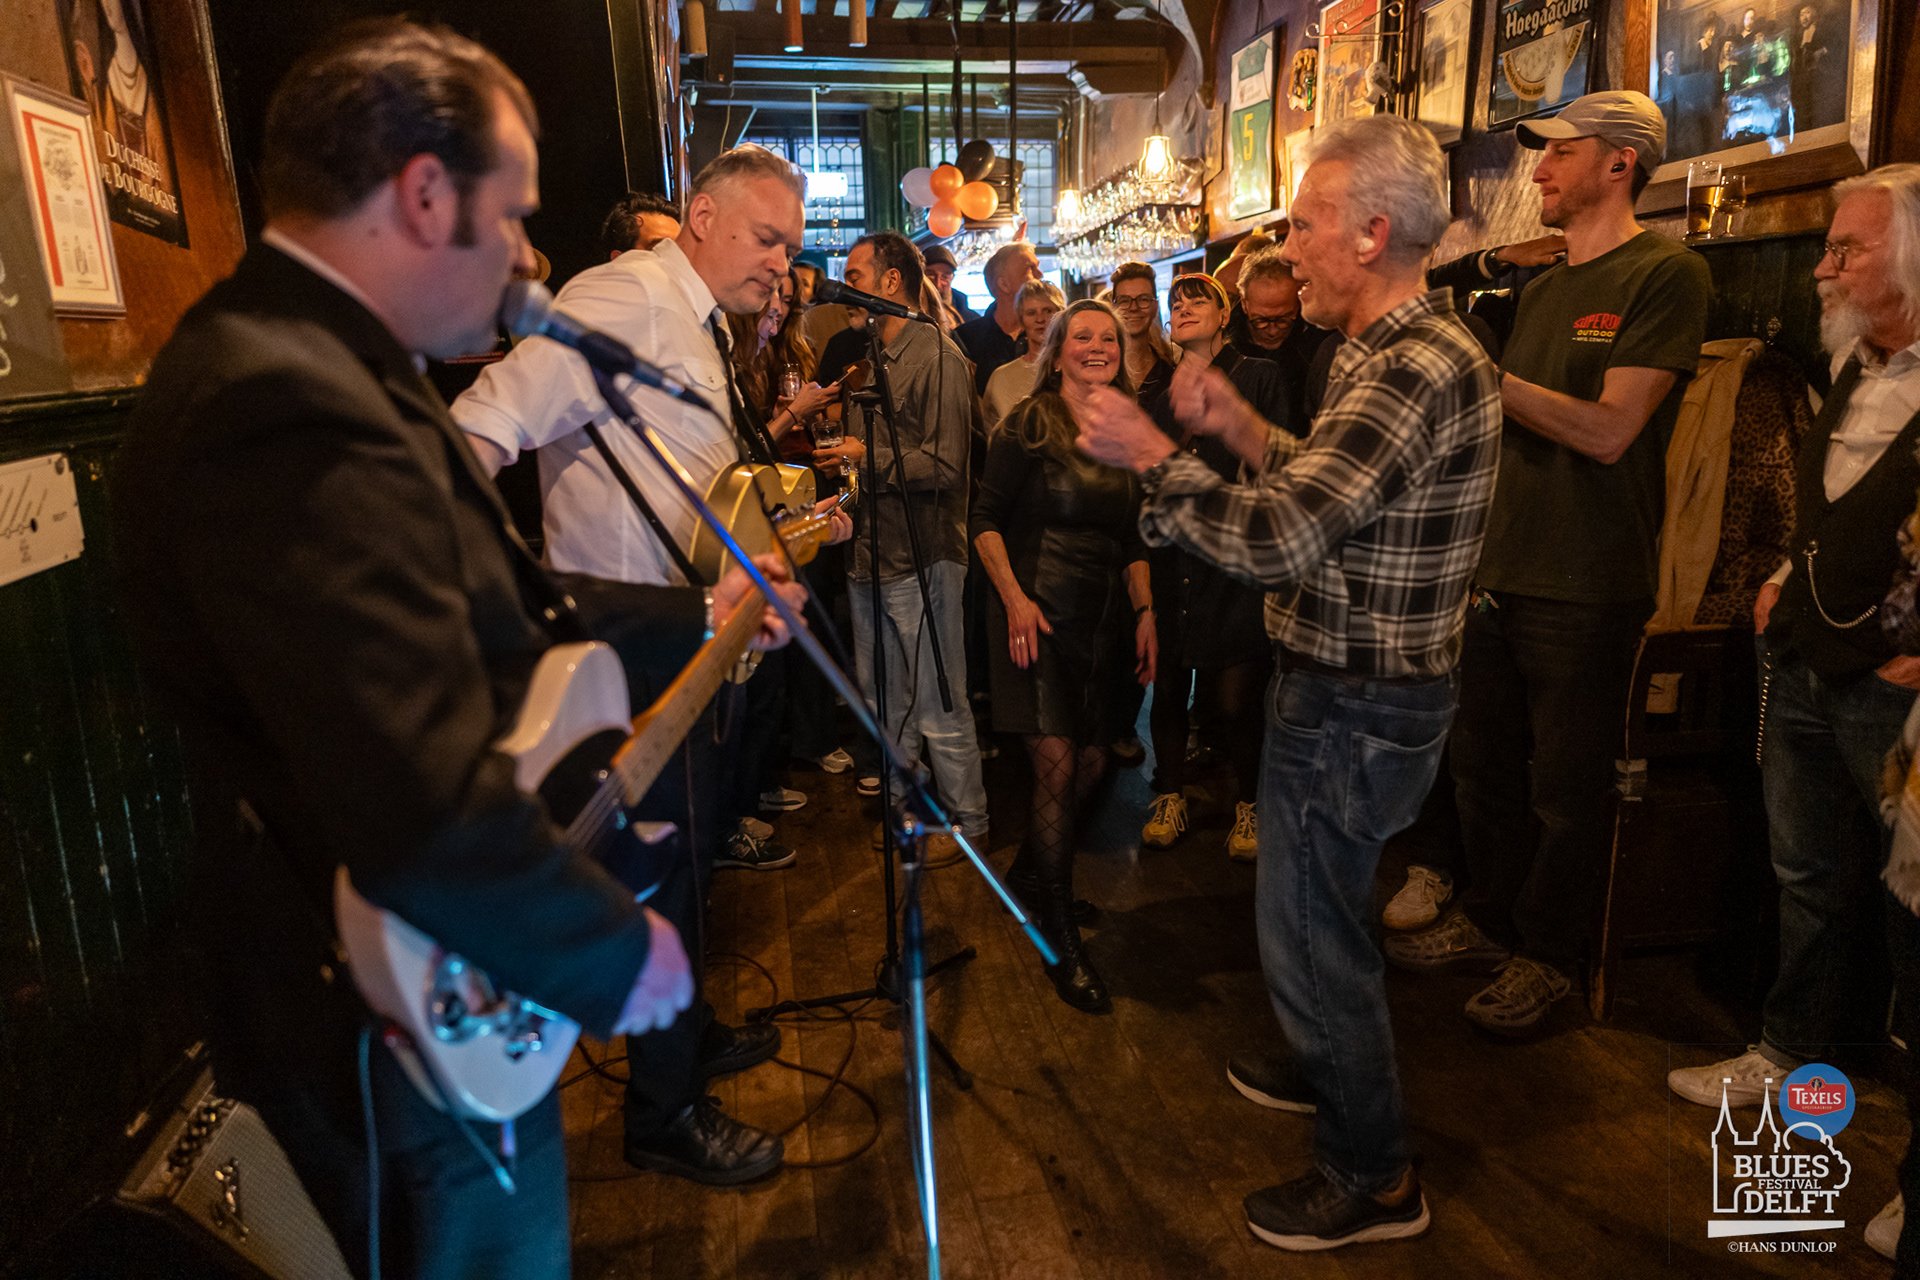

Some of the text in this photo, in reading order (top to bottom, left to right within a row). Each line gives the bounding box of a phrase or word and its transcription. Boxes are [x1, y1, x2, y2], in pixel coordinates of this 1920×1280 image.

[1506, 0, 1588, 39] Hoegaarden
[103, 130, 161, 181] DUCHESSE
[1243, 112, 1254, 161] 5
[112, 162, 178, 214] BOURGOGNE
